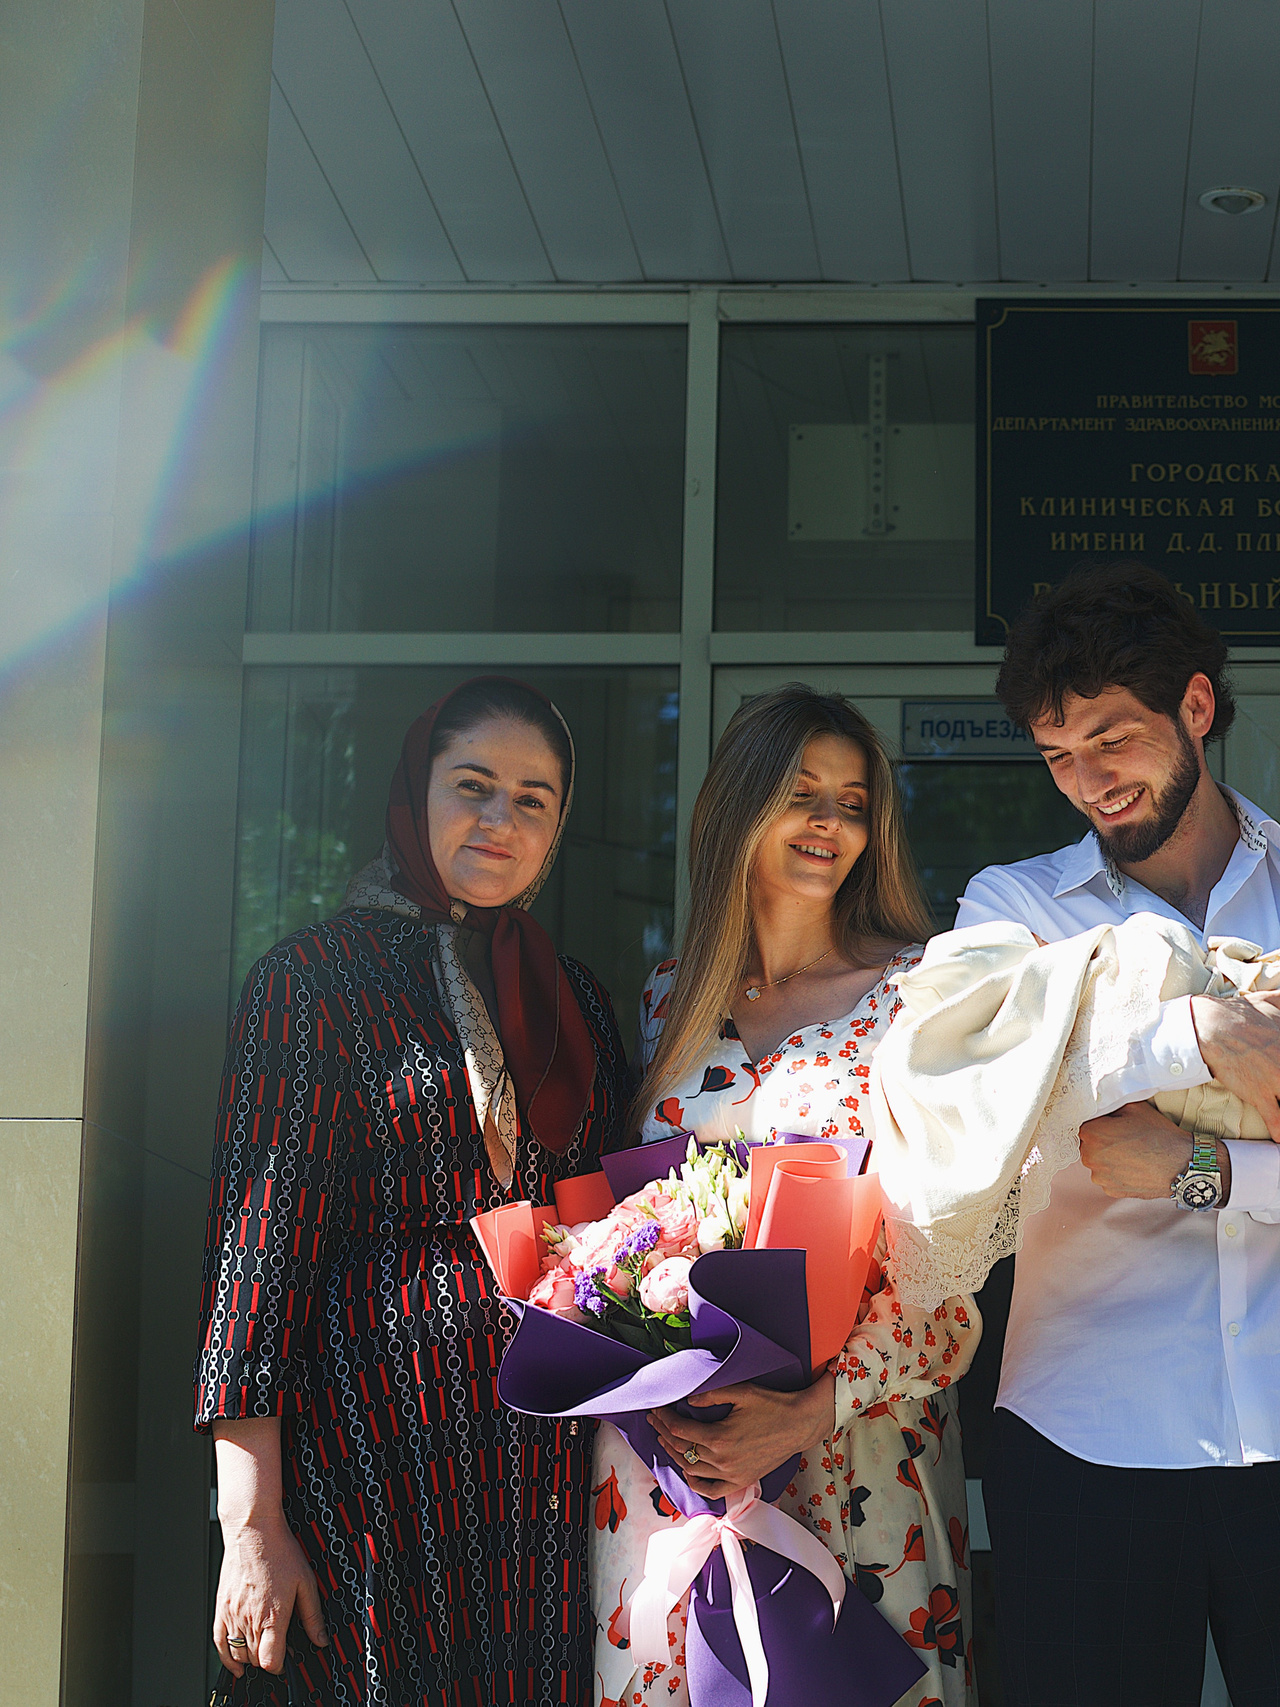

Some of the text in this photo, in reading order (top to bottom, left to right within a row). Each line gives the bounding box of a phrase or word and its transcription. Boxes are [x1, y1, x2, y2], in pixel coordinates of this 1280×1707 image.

[1096, 394, 1248, 410] ПРАВИТЕЛЬСТВО
[992, 416, 1116, 433] ДЕПАРТАМЕНТ
[1020, 497, 1236, 517] КЛИНИЧЕСКАЯ
[1050, 531, 1146, 552] ИМЕНИ
